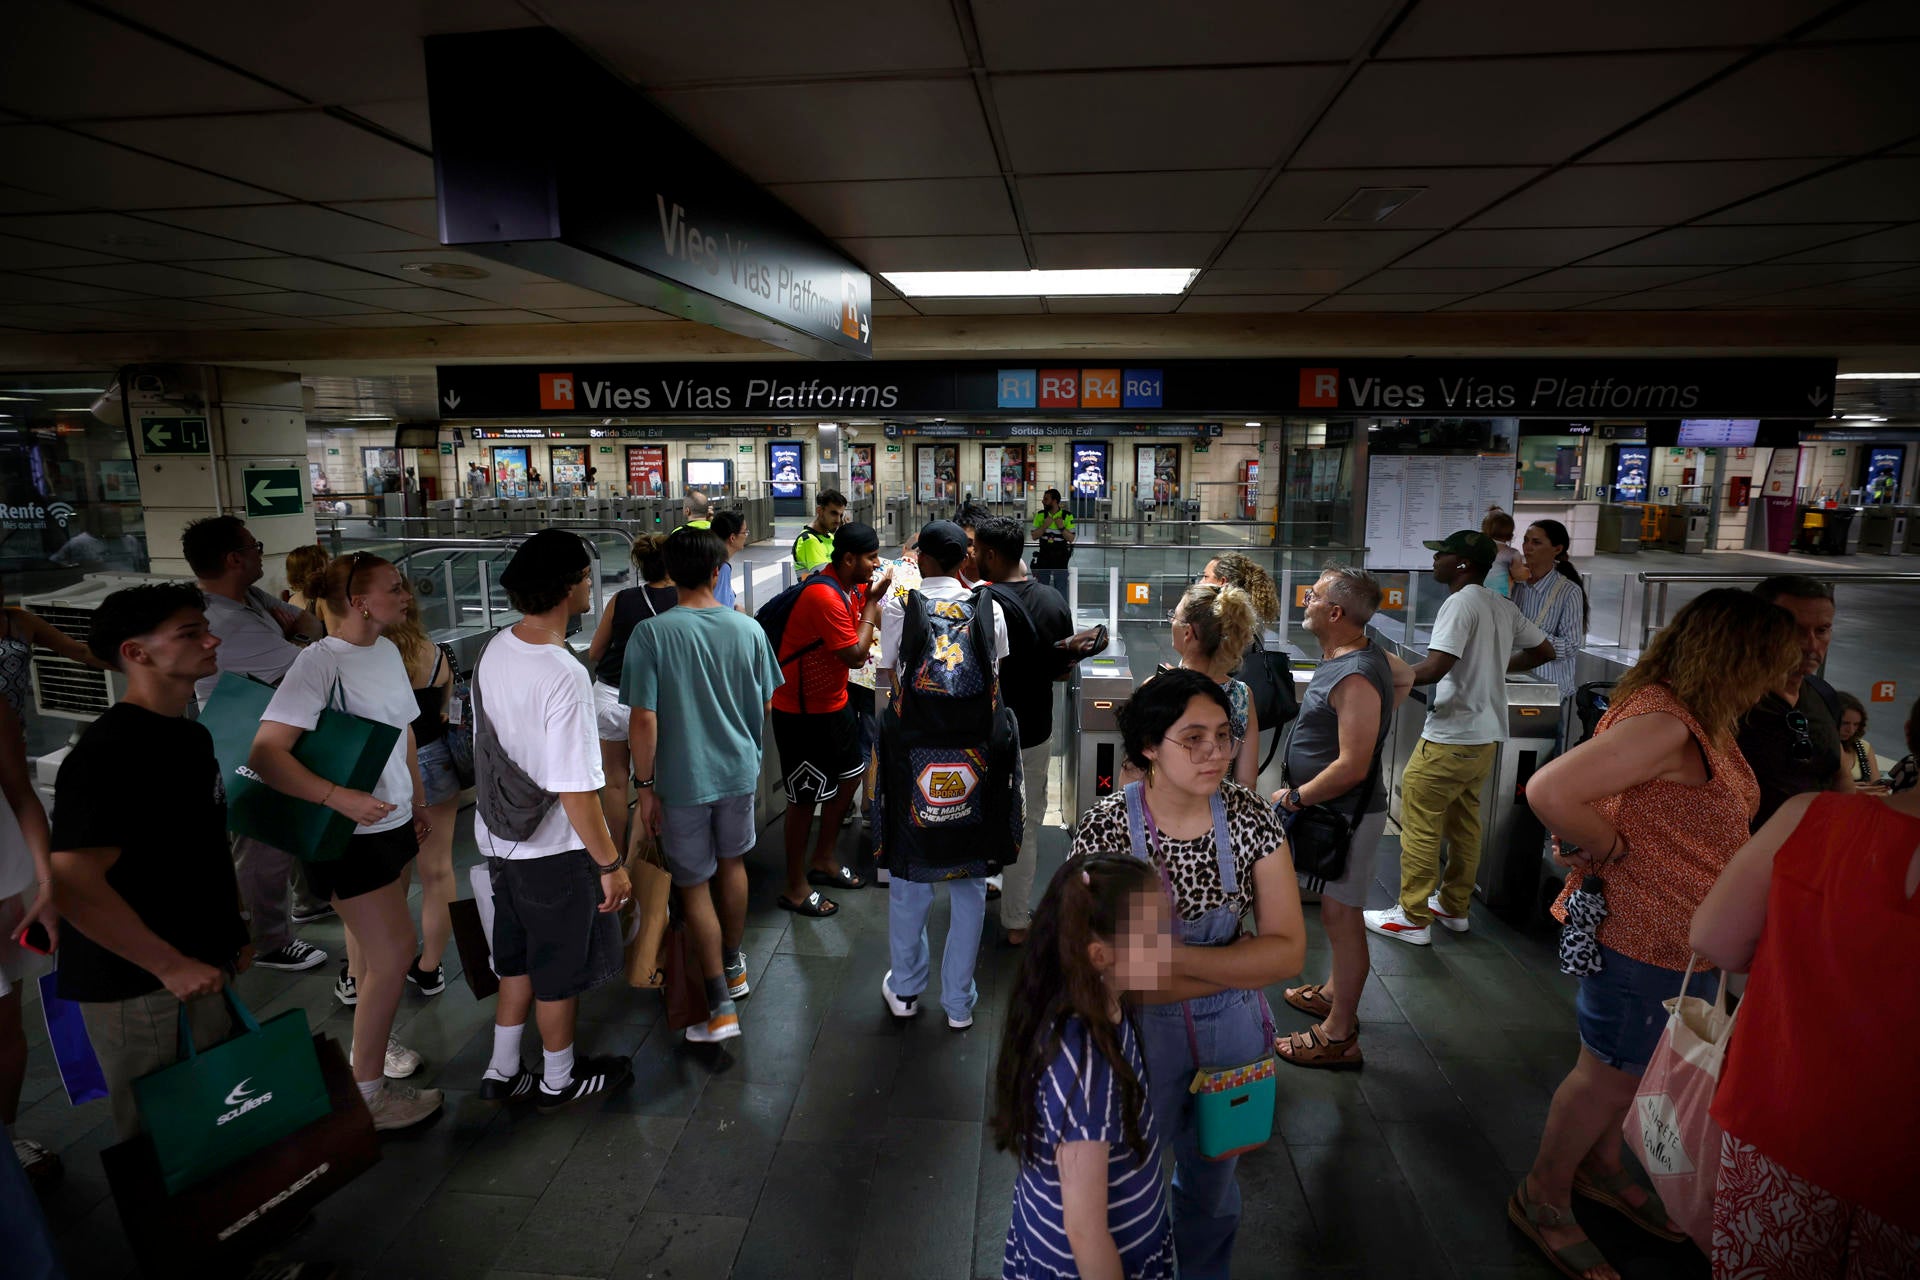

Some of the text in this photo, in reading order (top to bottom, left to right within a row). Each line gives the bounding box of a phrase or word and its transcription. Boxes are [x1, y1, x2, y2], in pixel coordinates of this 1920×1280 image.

[656, 193, 720, 277] Vies
[726, 233, 771, 299] Vías
[777, 263, 840, 330] Platforms
[553, 379, 899, 408] R Vies Vías Platforms
[1002, 378, 1160, 399] R1 R3 R4 RG1
[1315, 374, 1700, 408] R Vies Vías Platforms
[590, 428, 663, 437] Sortida Salida Exit
[1011, 427, 1093, 435] Sortida Salida Exit
[0, 502, 45, 519] Renfe
[1136, 586, 1148, 599] R
[1388, 591, 1402, 604] R
[1880, 684, 1895, 697] R
[930, 771, 966, 791] FA
[930, 789, 965, 798] SPORTS
[920, 806, 972, 823] CHEMPIONS
[926, 802, 968, 815] WE MAKE
